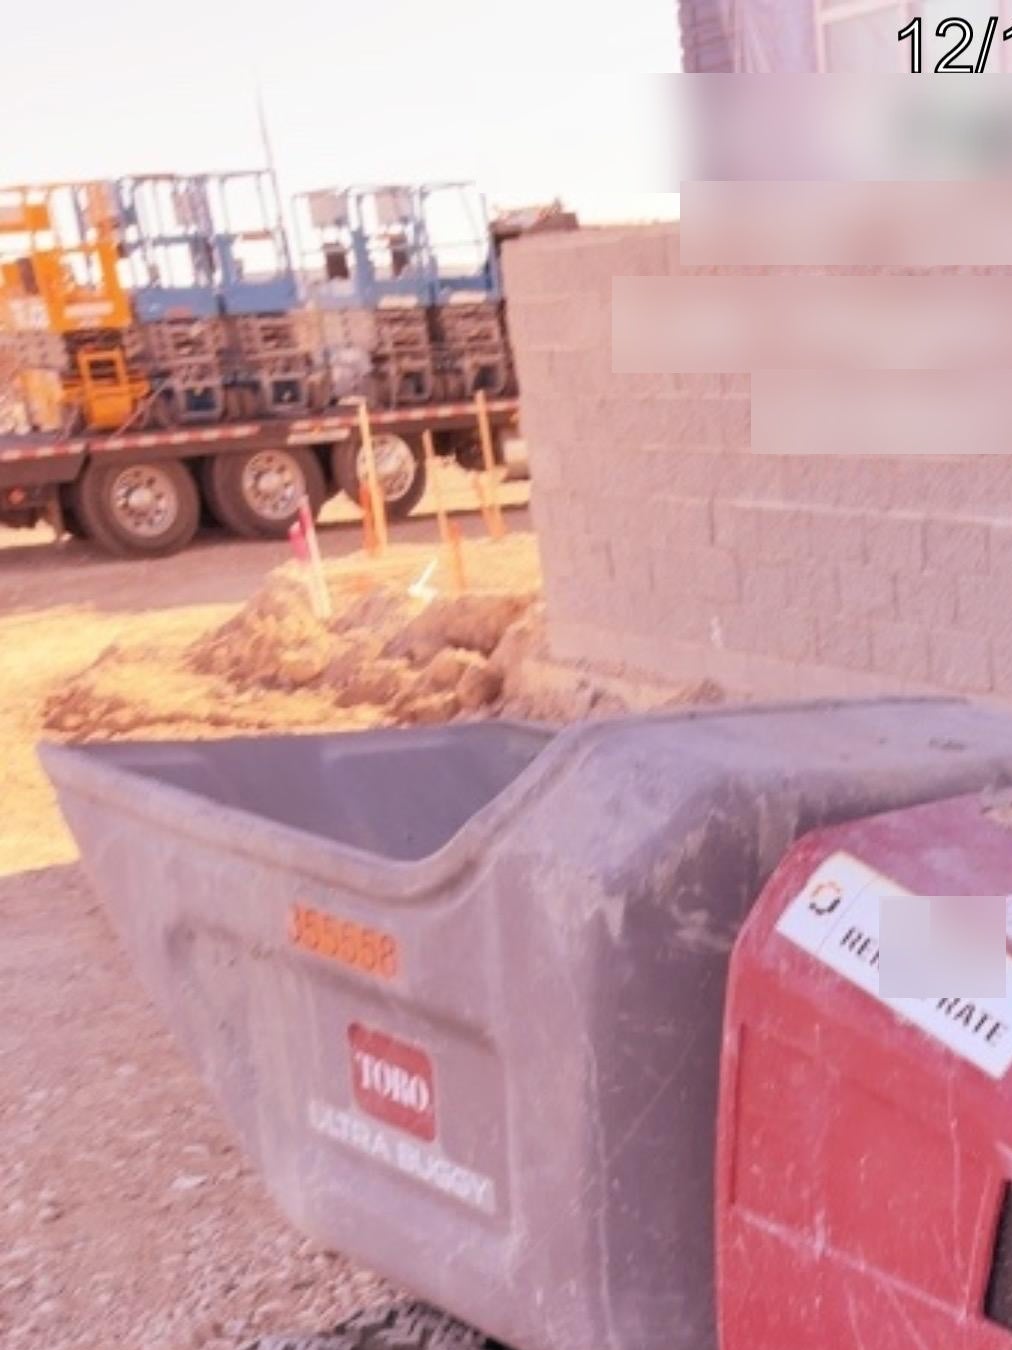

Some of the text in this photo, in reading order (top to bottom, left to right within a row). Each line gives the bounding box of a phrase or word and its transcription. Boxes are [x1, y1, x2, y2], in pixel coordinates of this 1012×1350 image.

[354, 1051, 430, 1113] TORO
[308, 1099, 493, 1208] ULTRA BUGGY
